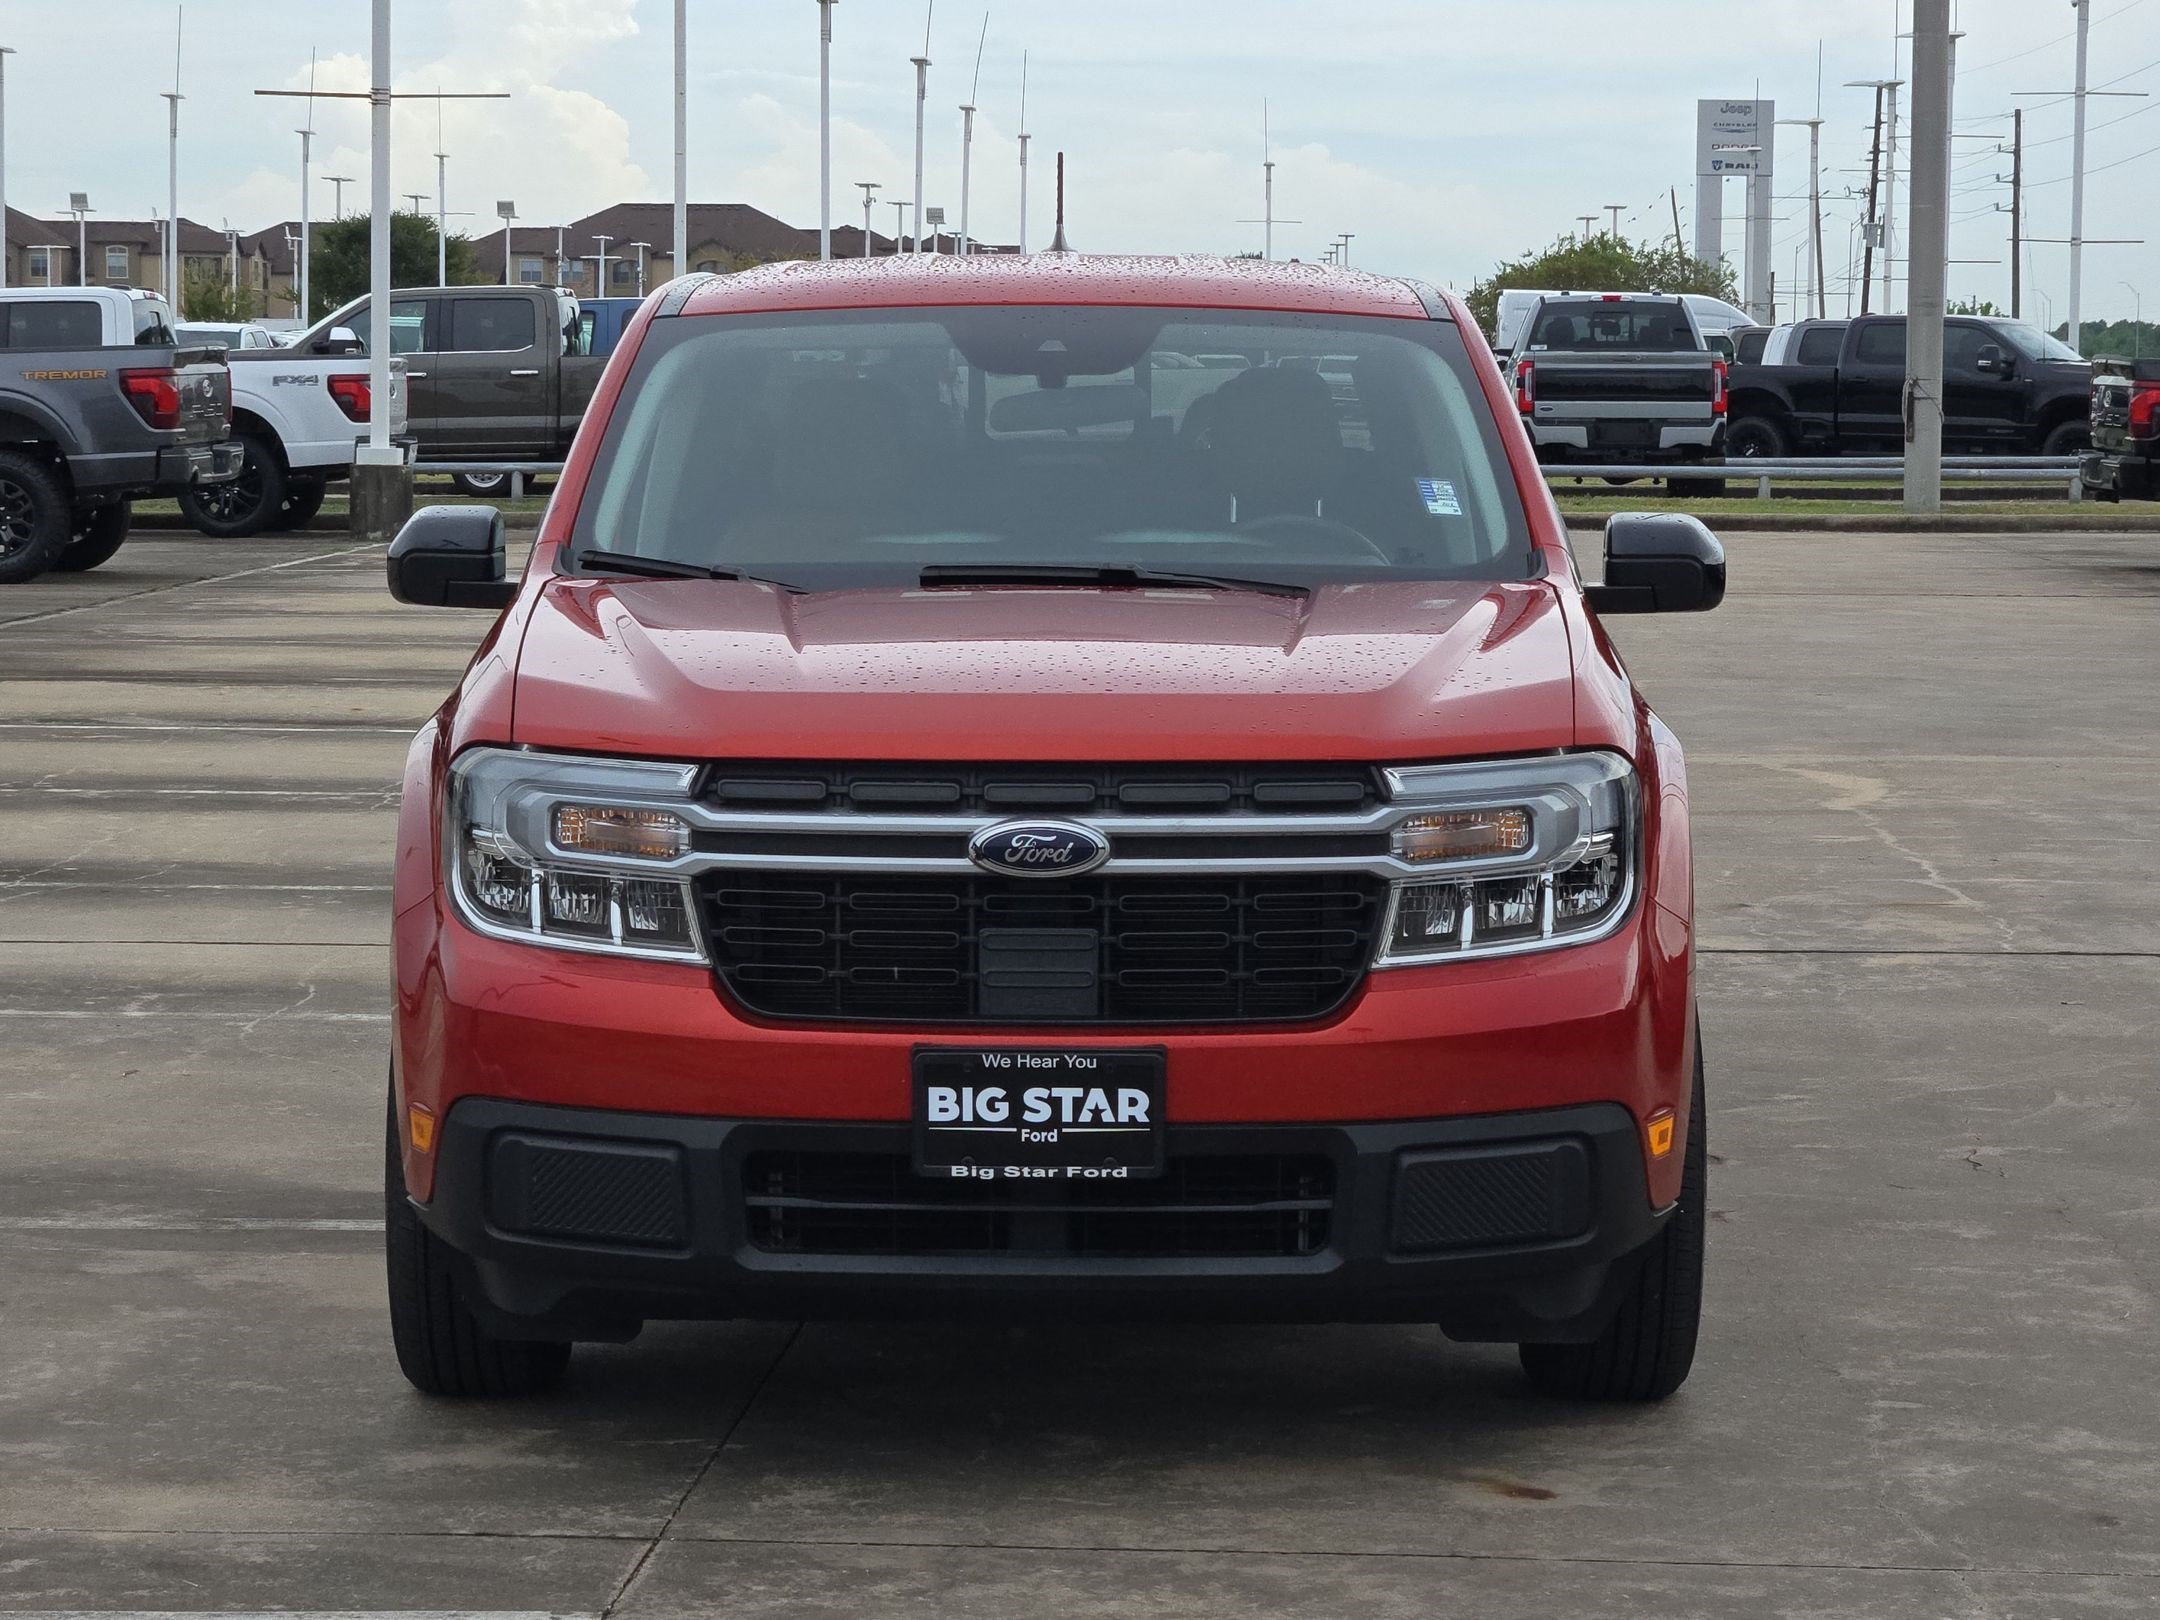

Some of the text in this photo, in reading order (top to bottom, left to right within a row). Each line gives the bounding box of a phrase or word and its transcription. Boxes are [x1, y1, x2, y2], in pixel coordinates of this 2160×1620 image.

[1720, 102, 1752, 116] Jeep
[22, 369, 108, 381] TREMOR
[272, 374, 319, 387] FX4
[1004, 834, 1073, 863] Ford
[982, 1053, 1097, 1069] We Hear You
[928, 1086, 1150, 1123] BIG STAR
[1021, 1128, 1058, 1142] Ford
[951, 1165, 1128, 1180] Big Star Ford
